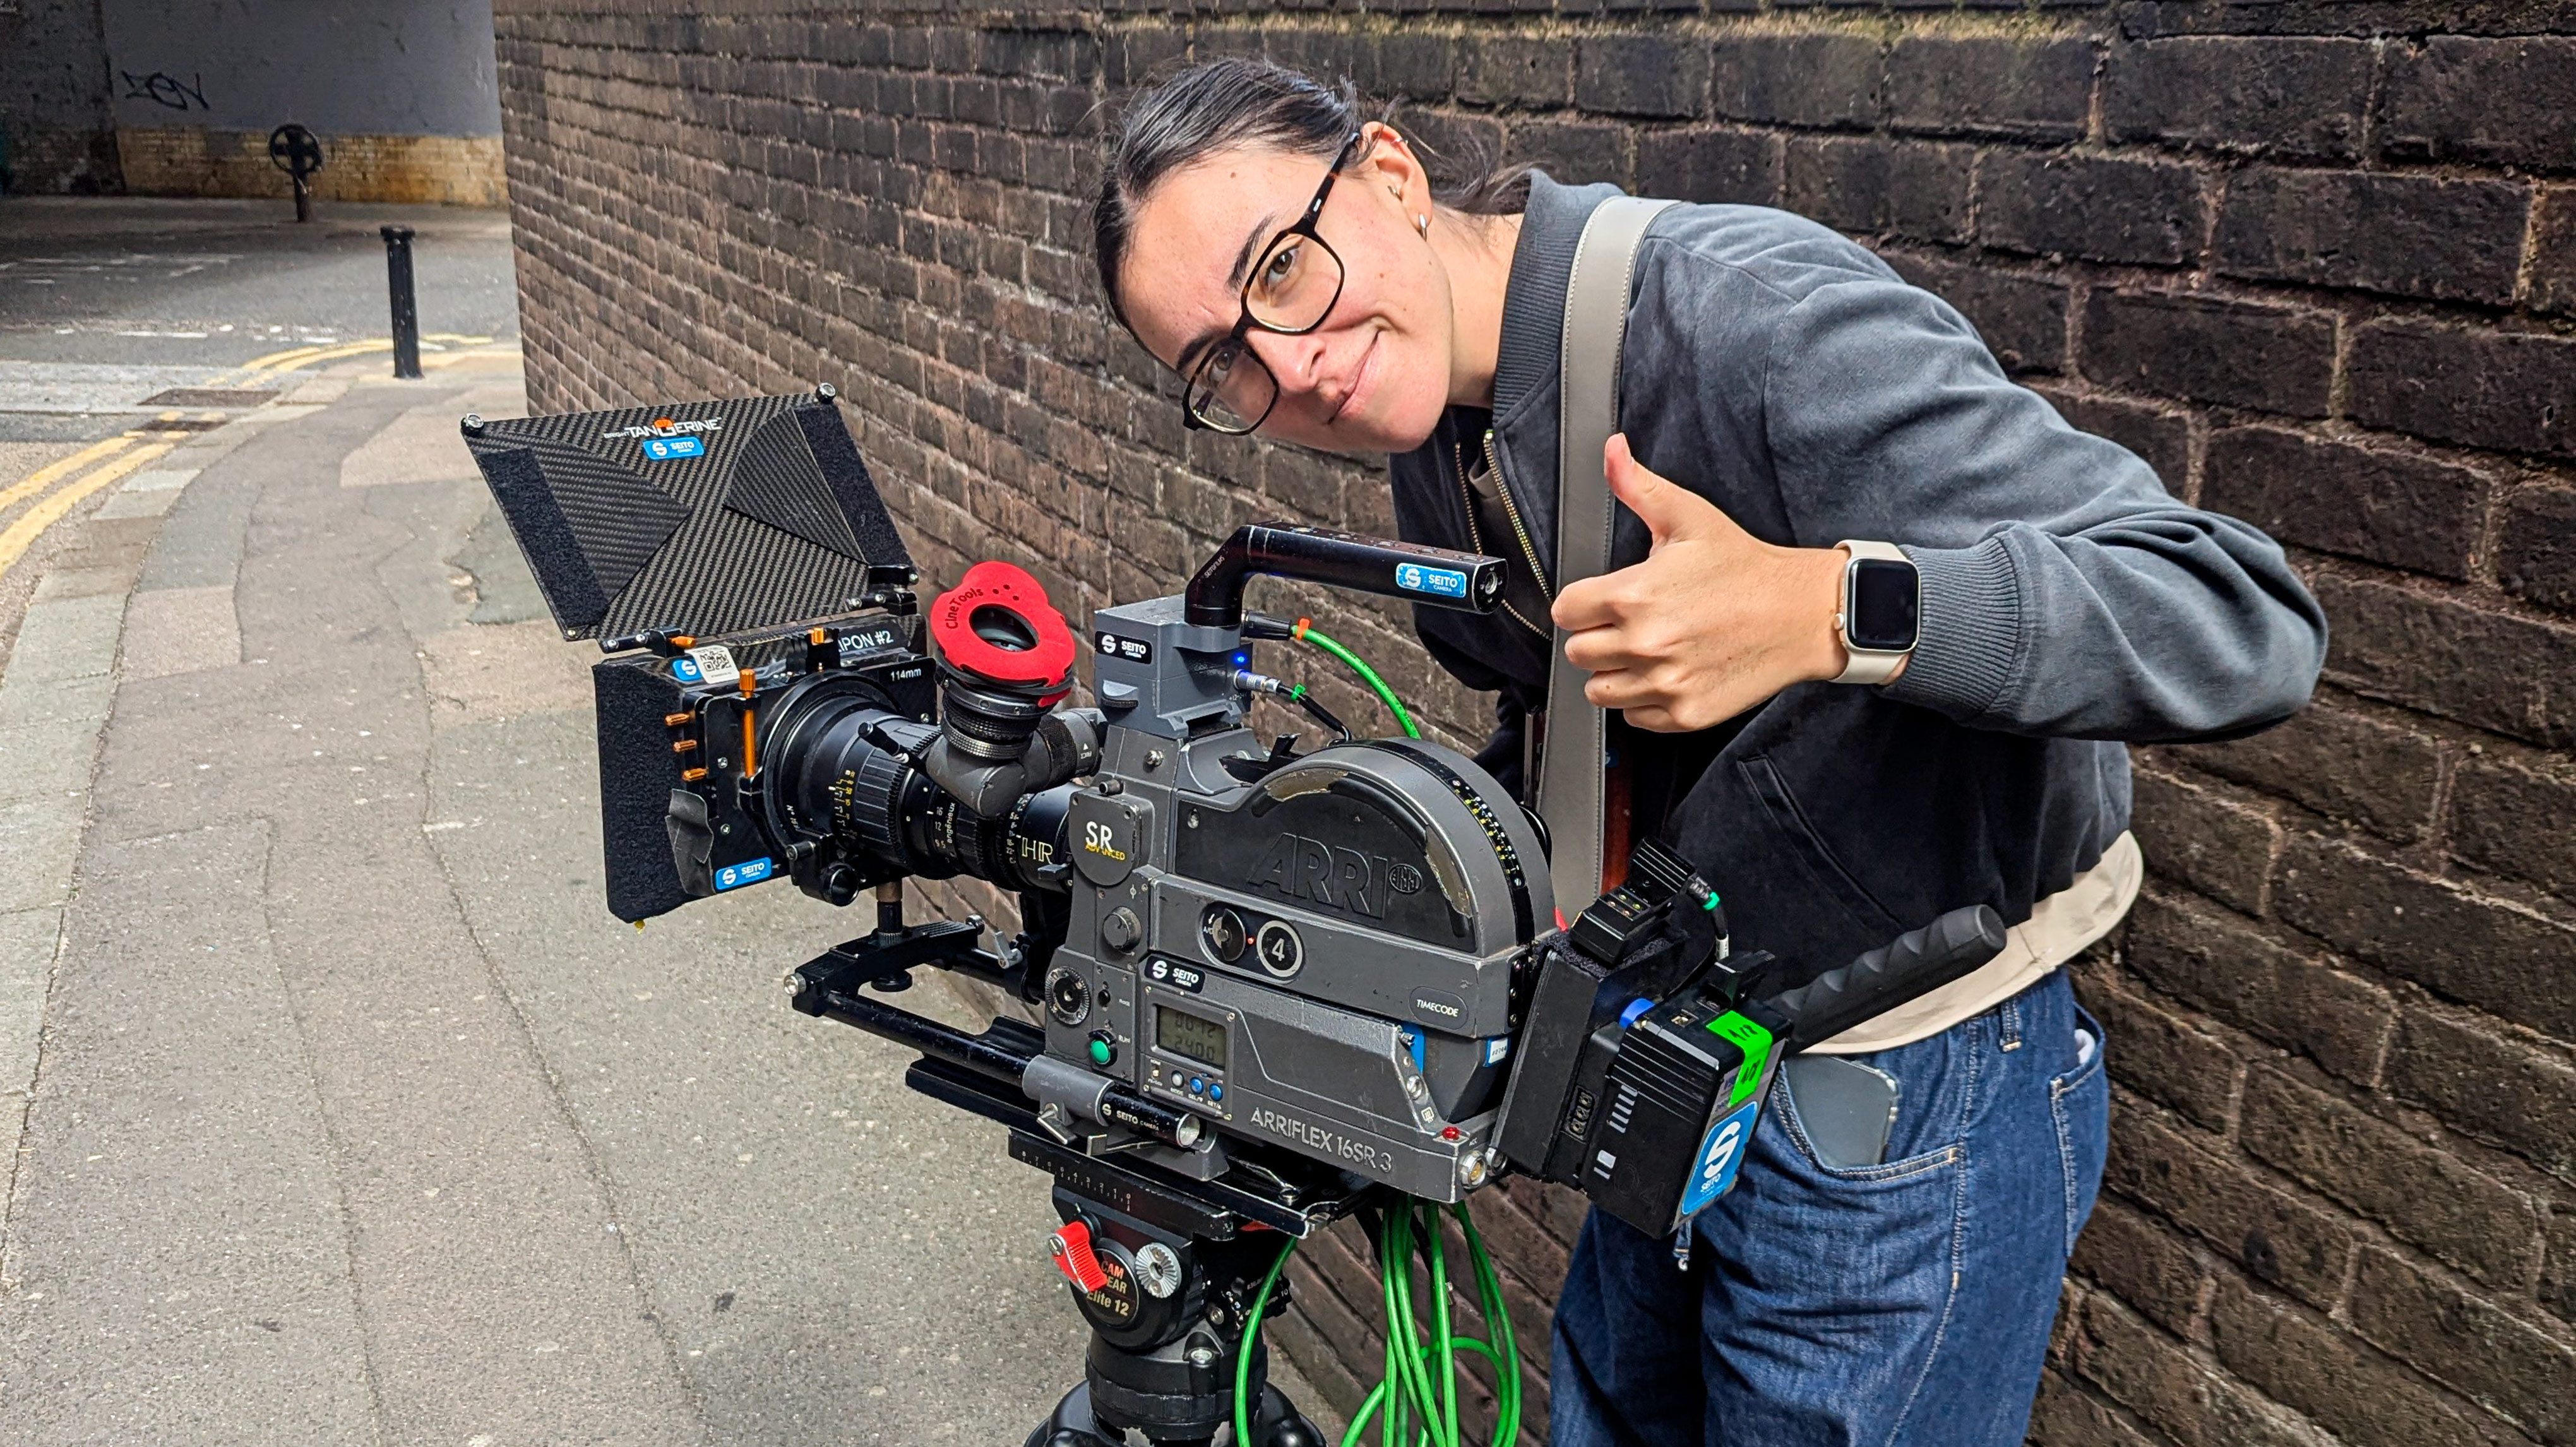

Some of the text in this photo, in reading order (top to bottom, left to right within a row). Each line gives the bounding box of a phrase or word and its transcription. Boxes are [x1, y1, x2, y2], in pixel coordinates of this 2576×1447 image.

[604, 417, 722, 439] BRIGHT TANGERINE
[670, 441, 695, 450] SEITO
[1428, 574, 1458, 588] SEITO
[838, 631, 894, 653] IPON #2
[1121, 640, 1147, 655] SEITO
[890, 668, 922, 682] 114mm
[936, 806, 944, 816] 16
[934, 821, 942, 831] 12
[1085, 821, 1113, 853] SR
[1022, 837, 1053, 865] HR
[741, 862, 765, 876] SEITO
[1246, 831, 1389, 920] ARRI
[1271, 938, 1285, 962] 4
[1172, 967, 1199, 984] SEITO
[1416, 999, 1459, 1017] TIMECODE
[1116, 1110, 1138, 1124] SEITO
[1250, 1107, 1393, 1173] ARRIFLEX 16SR 3
[1100, 1260, 1124, 1280] CAM
[1106, 1275, 1128, 1294] EAR
[1086, 1289, 1130, 1316] Elite 12
